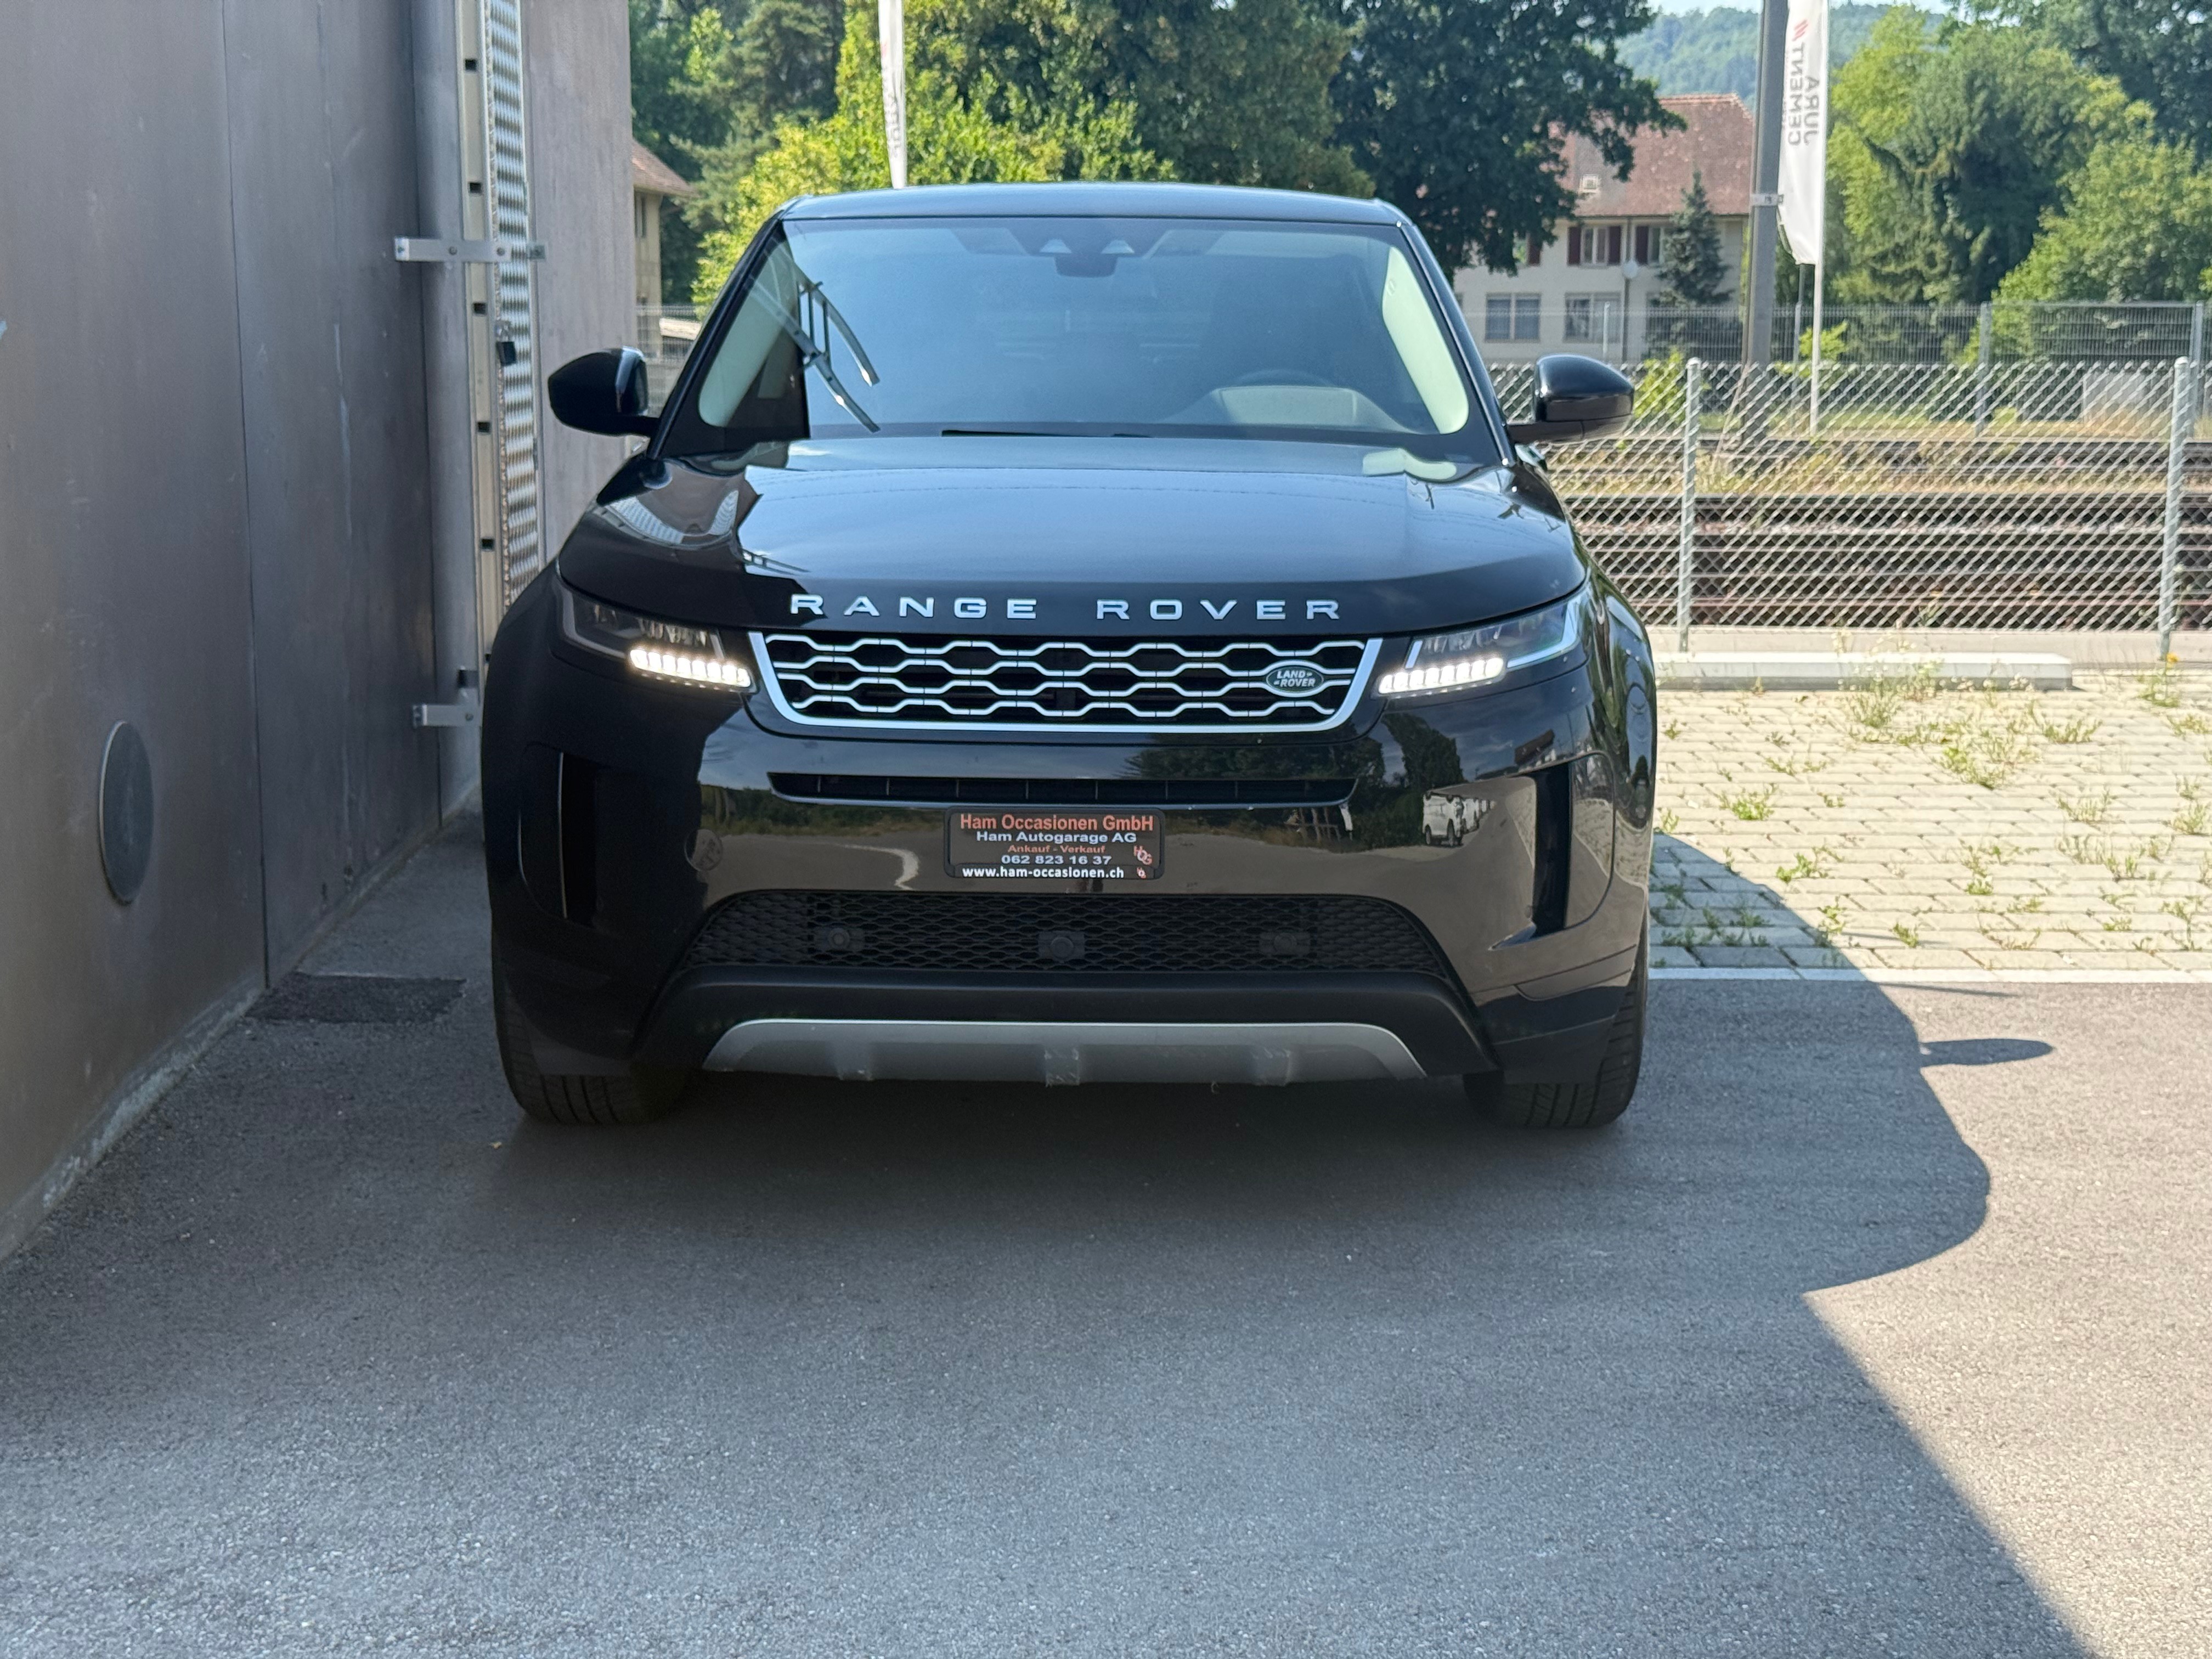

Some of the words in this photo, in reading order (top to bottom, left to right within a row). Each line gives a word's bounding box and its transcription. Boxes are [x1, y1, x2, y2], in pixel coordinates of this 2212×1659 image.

[790, 594, 1038, 620] RANGE
[1098, 599, 1340, 620] ROVER
[1277, 669, 1306, 679] LAND
[1279, 678, 1316, 687] ROVER
[960, 814, 997, 830] Ham
[1001, 814, 1098, 831] Occasionen
[1103, 815, 1154, 831] GmbH
[977, 831, 1012, 842] Ham
[1016, 831, 1108, 844] Autogarage
[1111, 832, 1137, 843] AG
[1007, 844, 1051, 853] Ankauf
[1060, 845, 1105, 854] Verkauf
[1001, 855, 1030, 864] 062
[1035, 855, 1064, 865] 823
[1069, 855, 1088, 865] 16
[1092, 856, 1112, 865] 37
[962, 866, 1124, 879] www.ham-occasionen.ch
